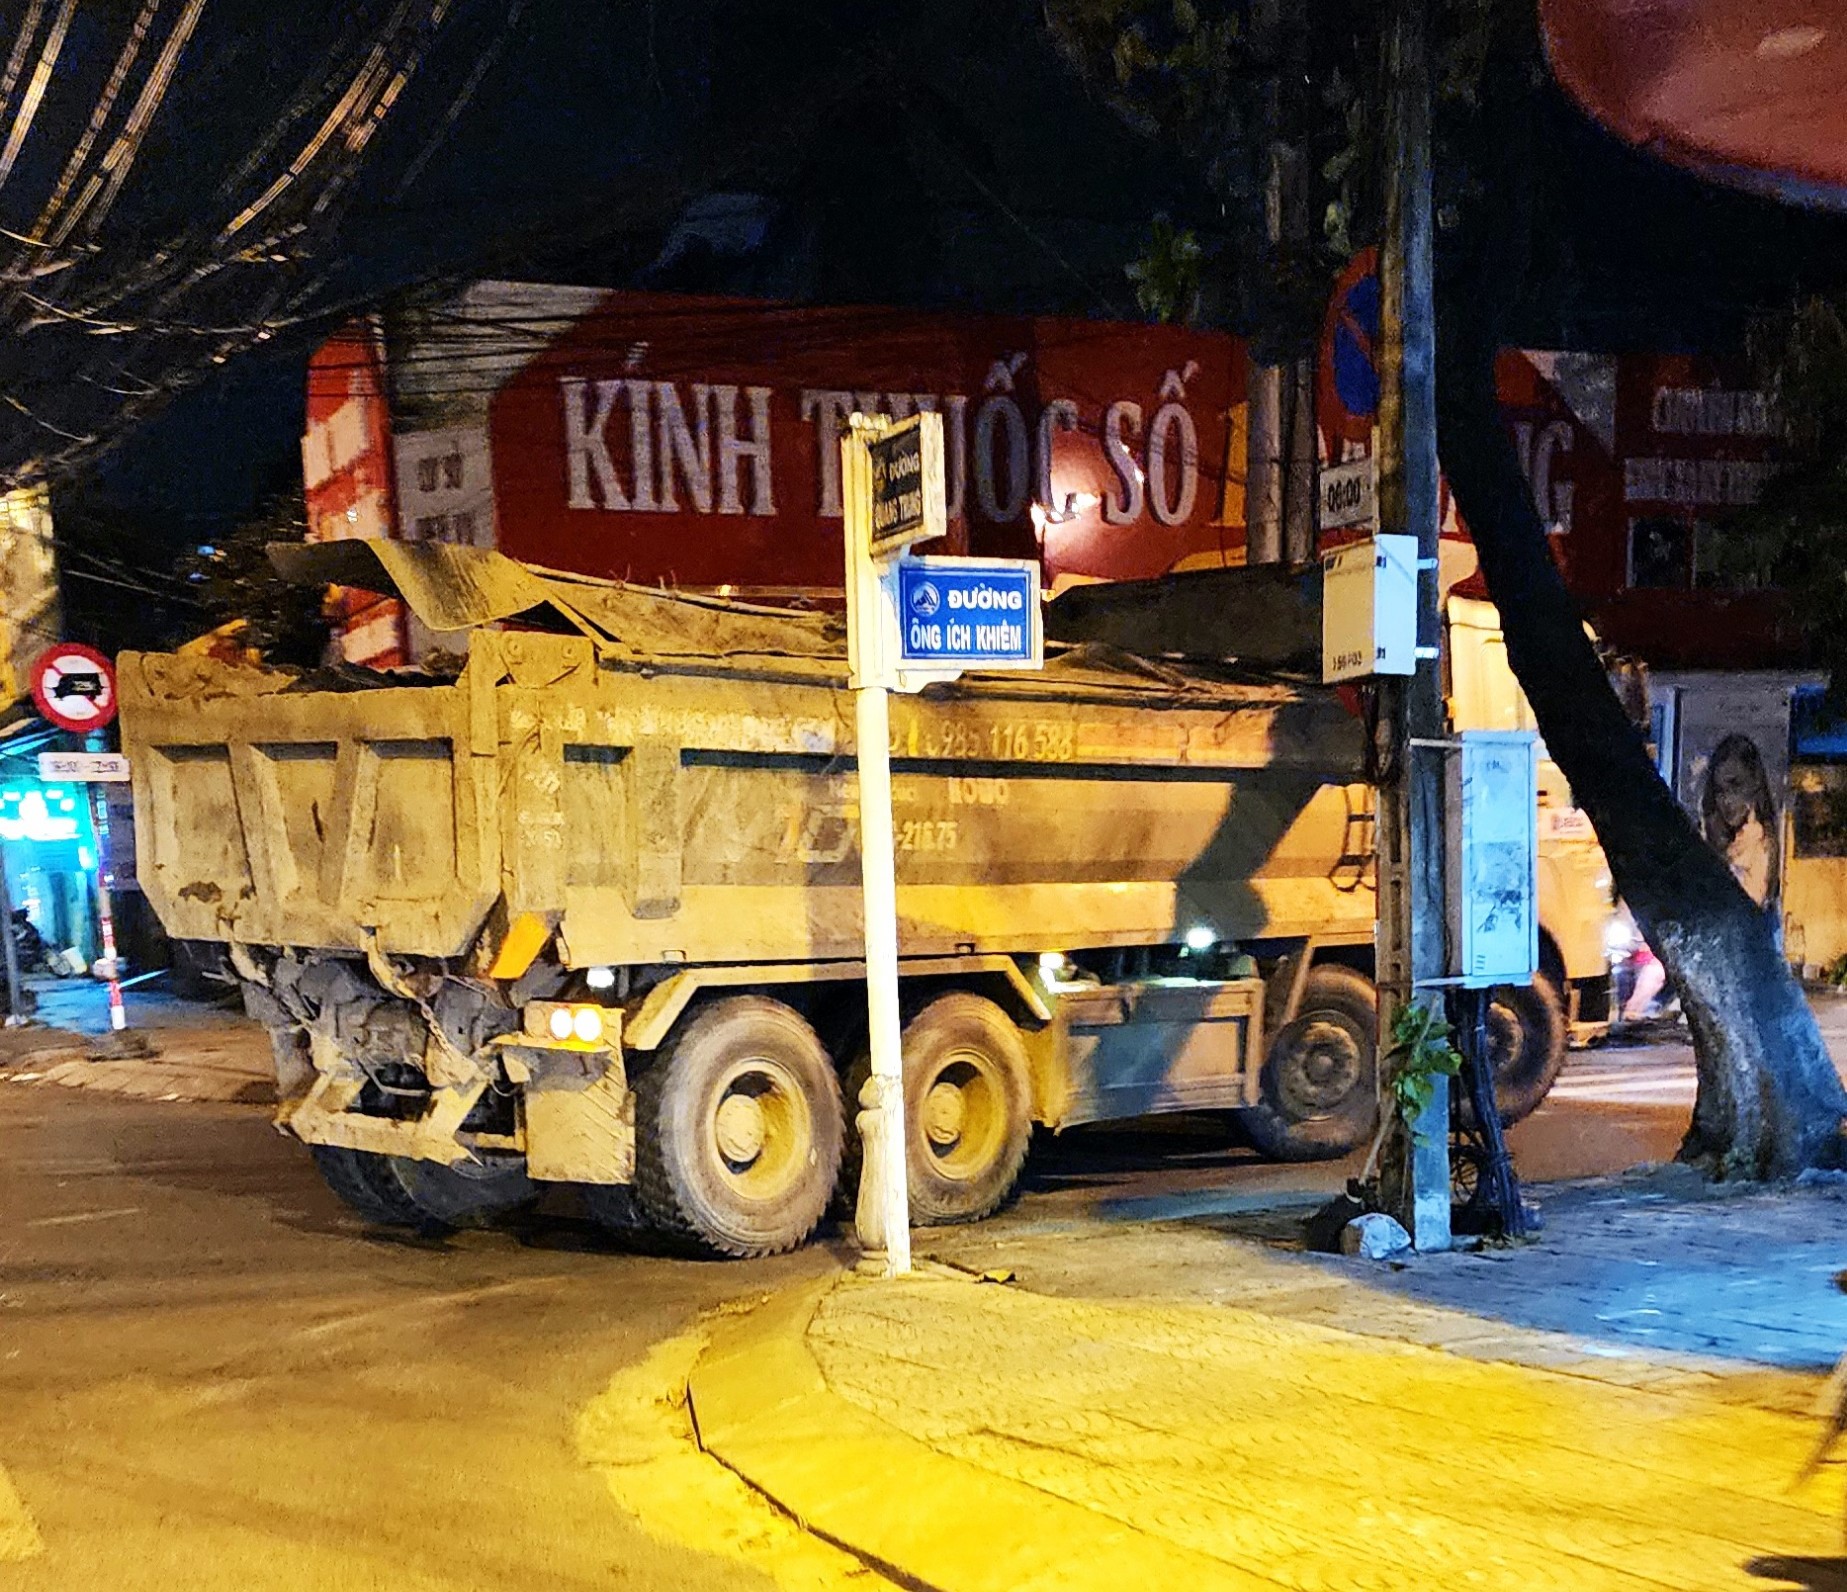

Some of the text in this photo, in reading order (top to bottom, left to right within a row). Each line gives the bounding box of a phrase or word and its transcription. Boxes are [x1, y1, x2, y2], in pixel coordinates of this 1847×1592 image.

[560, 342, 777, 516] KÍNH
[801, 351, 1083, 524] TỐC
[1104, 359, 1201, 527] SỐ
[948, 583, 1023, 610] ĐƯỜNG
[910, 617, 1022, 651] ÔNG ÍCH KHIÊM
